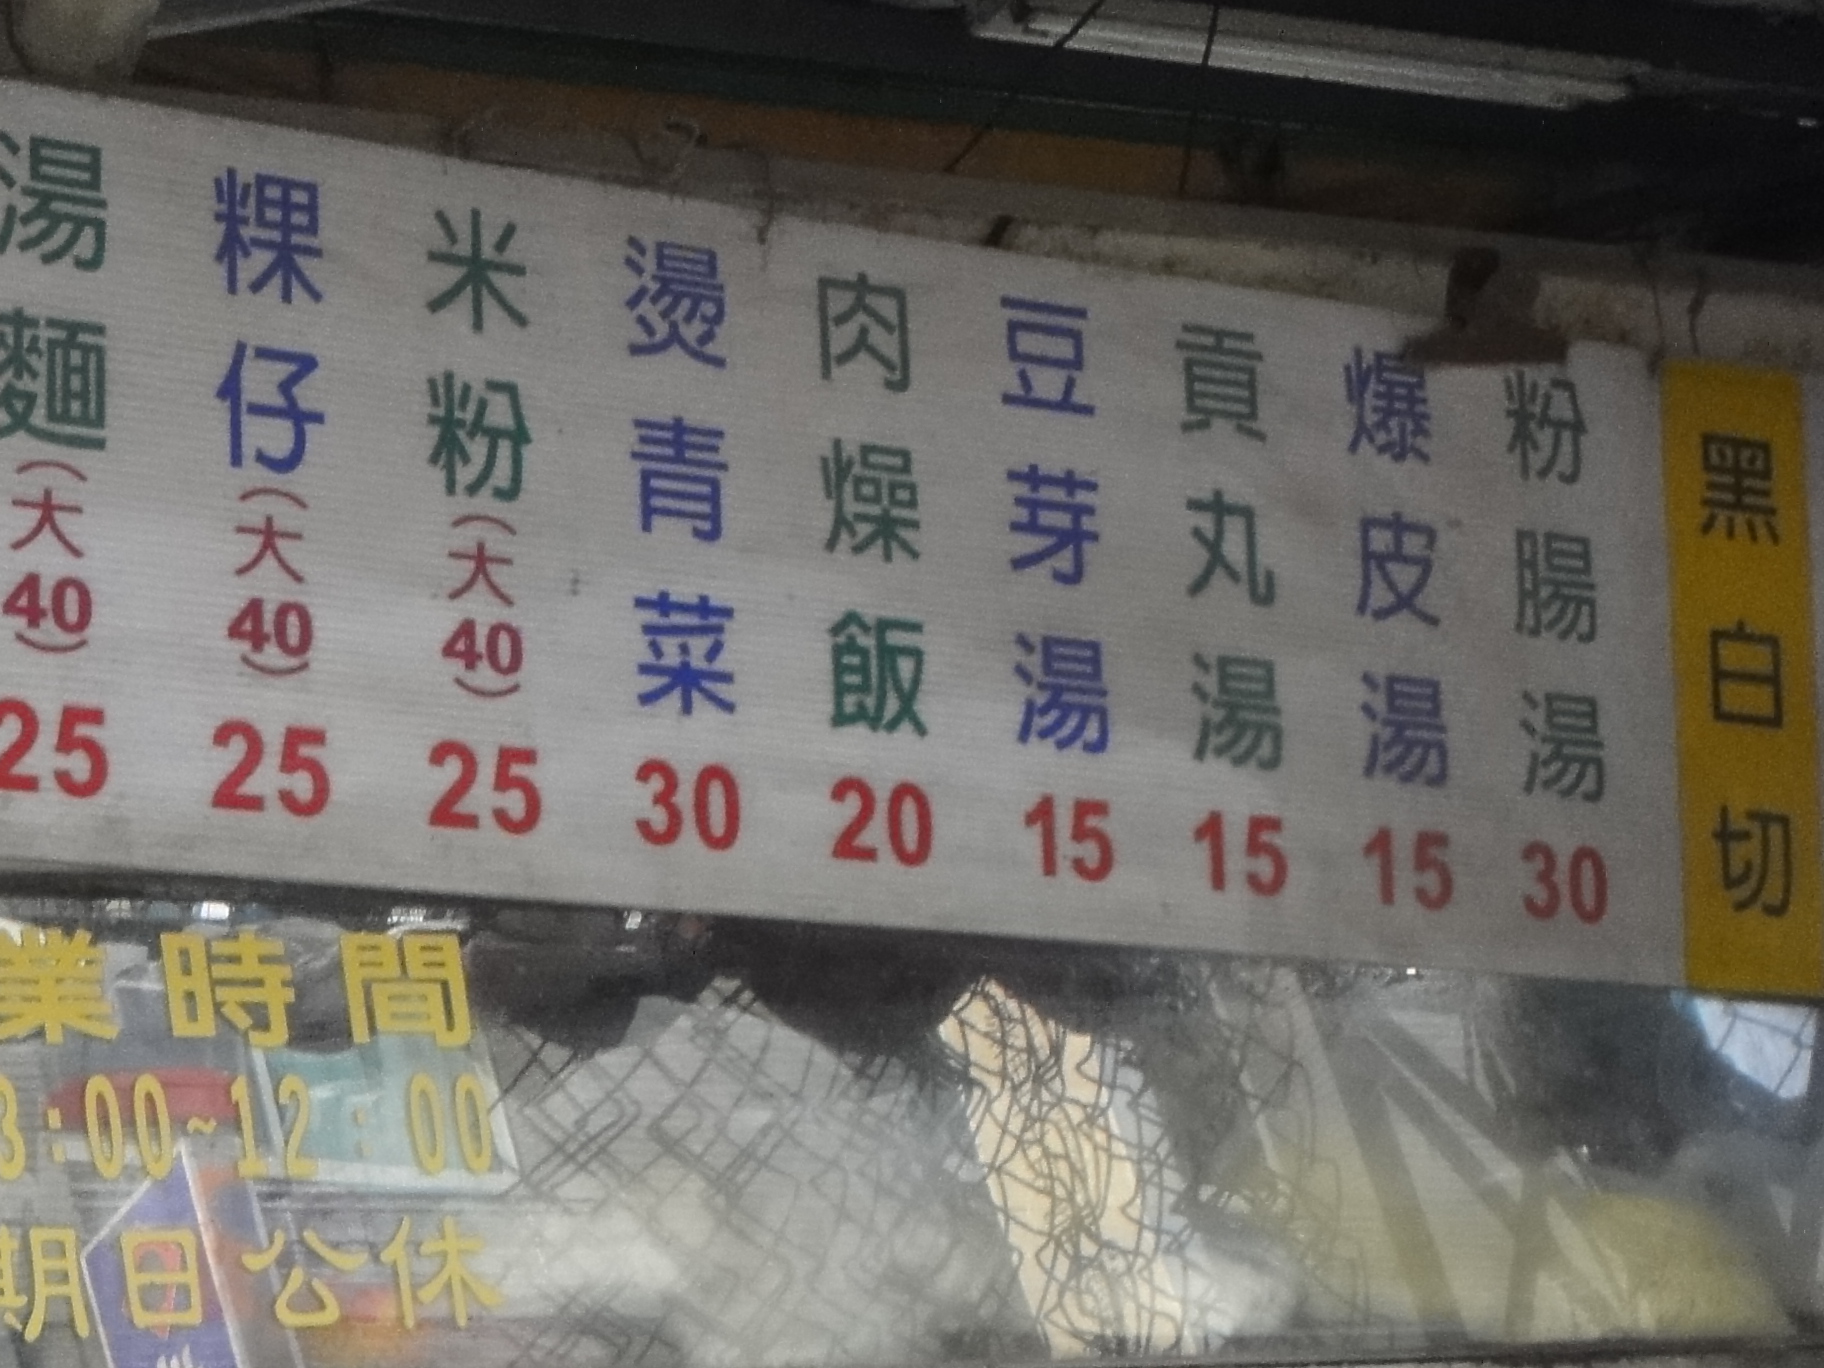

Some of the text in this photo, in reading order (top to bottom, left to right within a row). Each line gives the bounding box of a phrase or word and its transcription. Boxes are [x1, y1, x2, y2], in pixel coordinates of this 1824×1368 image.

[213, 167, 325, 474] 粿仔
[426, 208, 532, 504] 米粉
[624, 234, 740, 851] 燙青菜 30
[211, 720, 331, 817] 25
[427, 741, 542, 836] 25
[817, 272, 934, 868] 肉燥飯 20
[1000, 294, 1116, 883] 豆芽湯 15
[1175, 323, 1289, 897] 貢丸湯 15
[1504, 369, 1609, 925] 粉腸湯 30
[1699, 431, 1795, 918] 黑白切
[1362, 828, 1455, 911] 15
